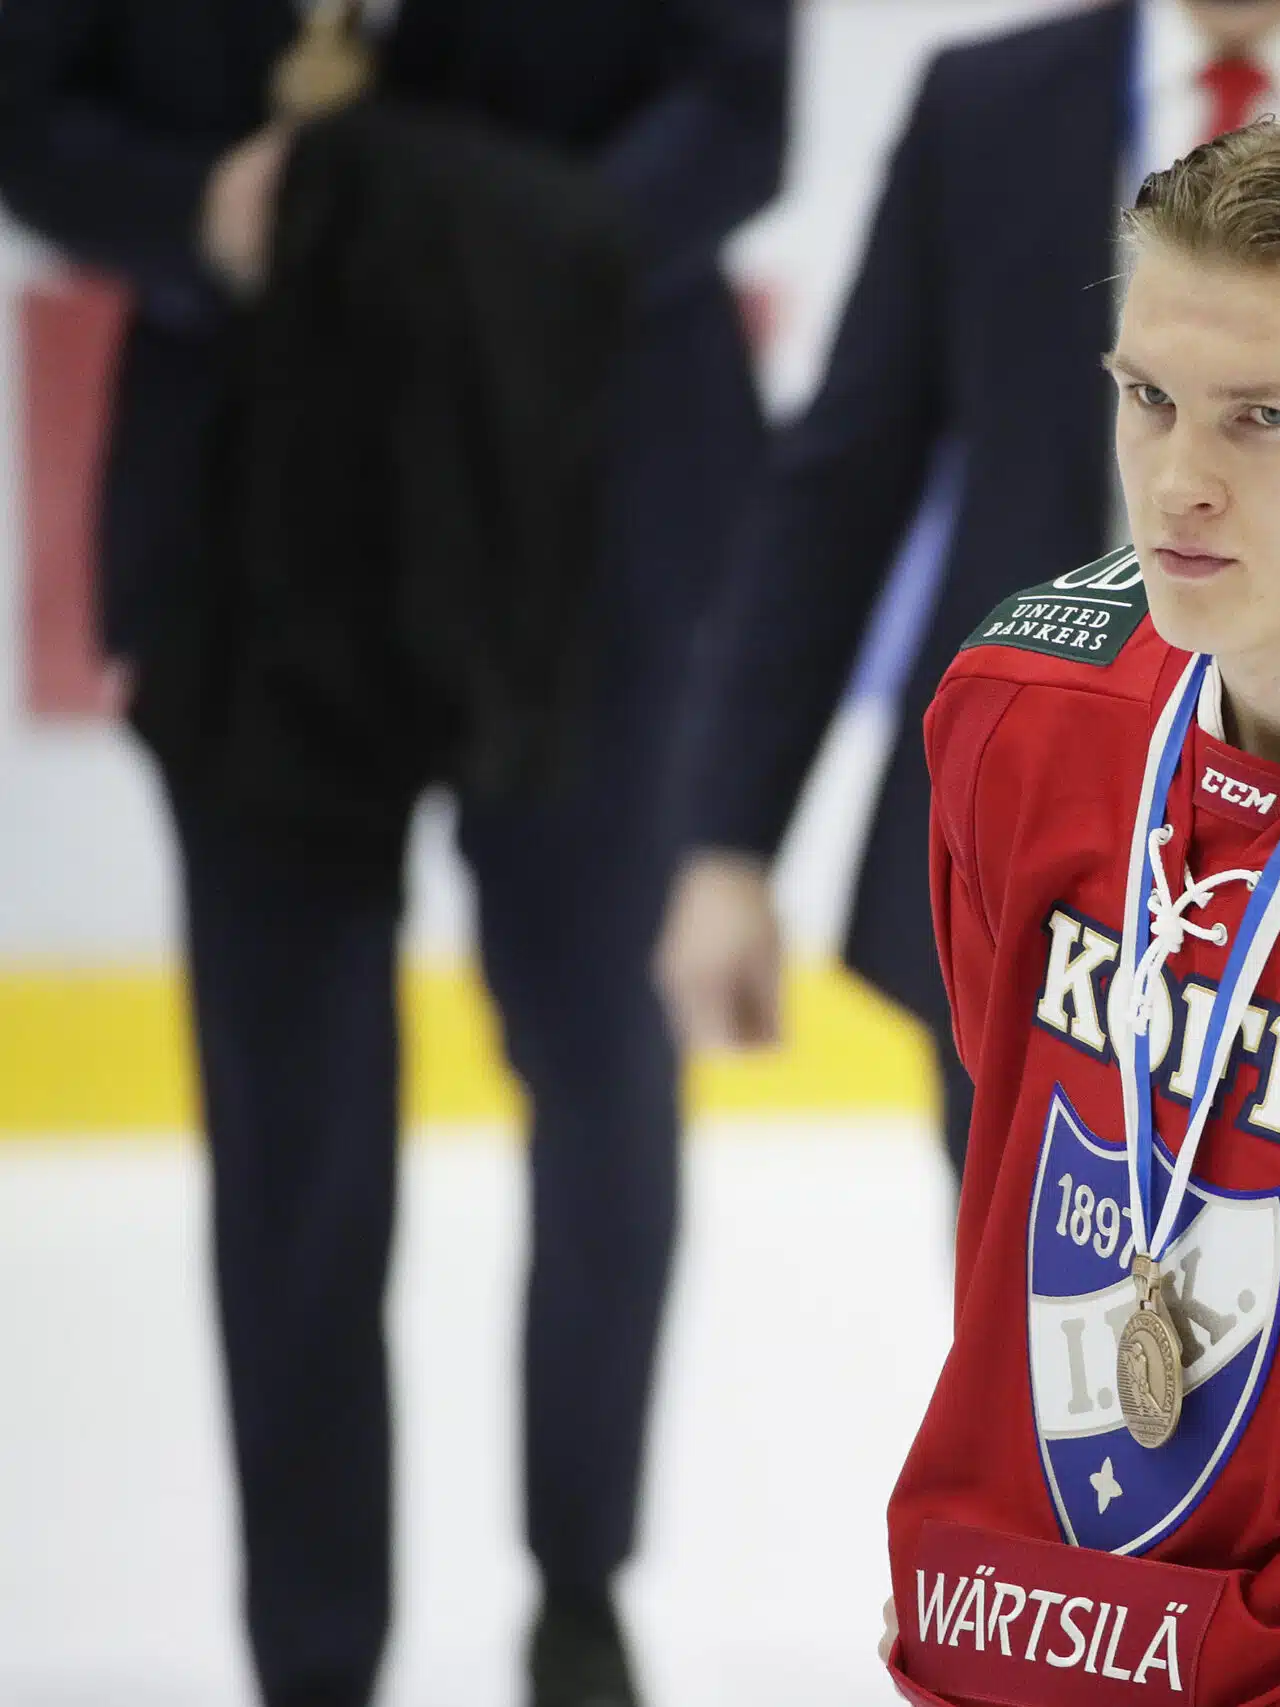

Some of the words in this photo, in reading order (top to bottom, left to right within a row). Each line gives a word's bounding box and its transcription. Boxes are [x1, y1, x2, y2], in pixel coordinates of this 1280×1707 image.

[982, 621, 1109, 651] BANKERS
[1011, 603, 1111, 629] UNITED
[1200, 766, 1279, 816] CCM
[915, 1564, 1189, 1692] WÄRTSILÄ
